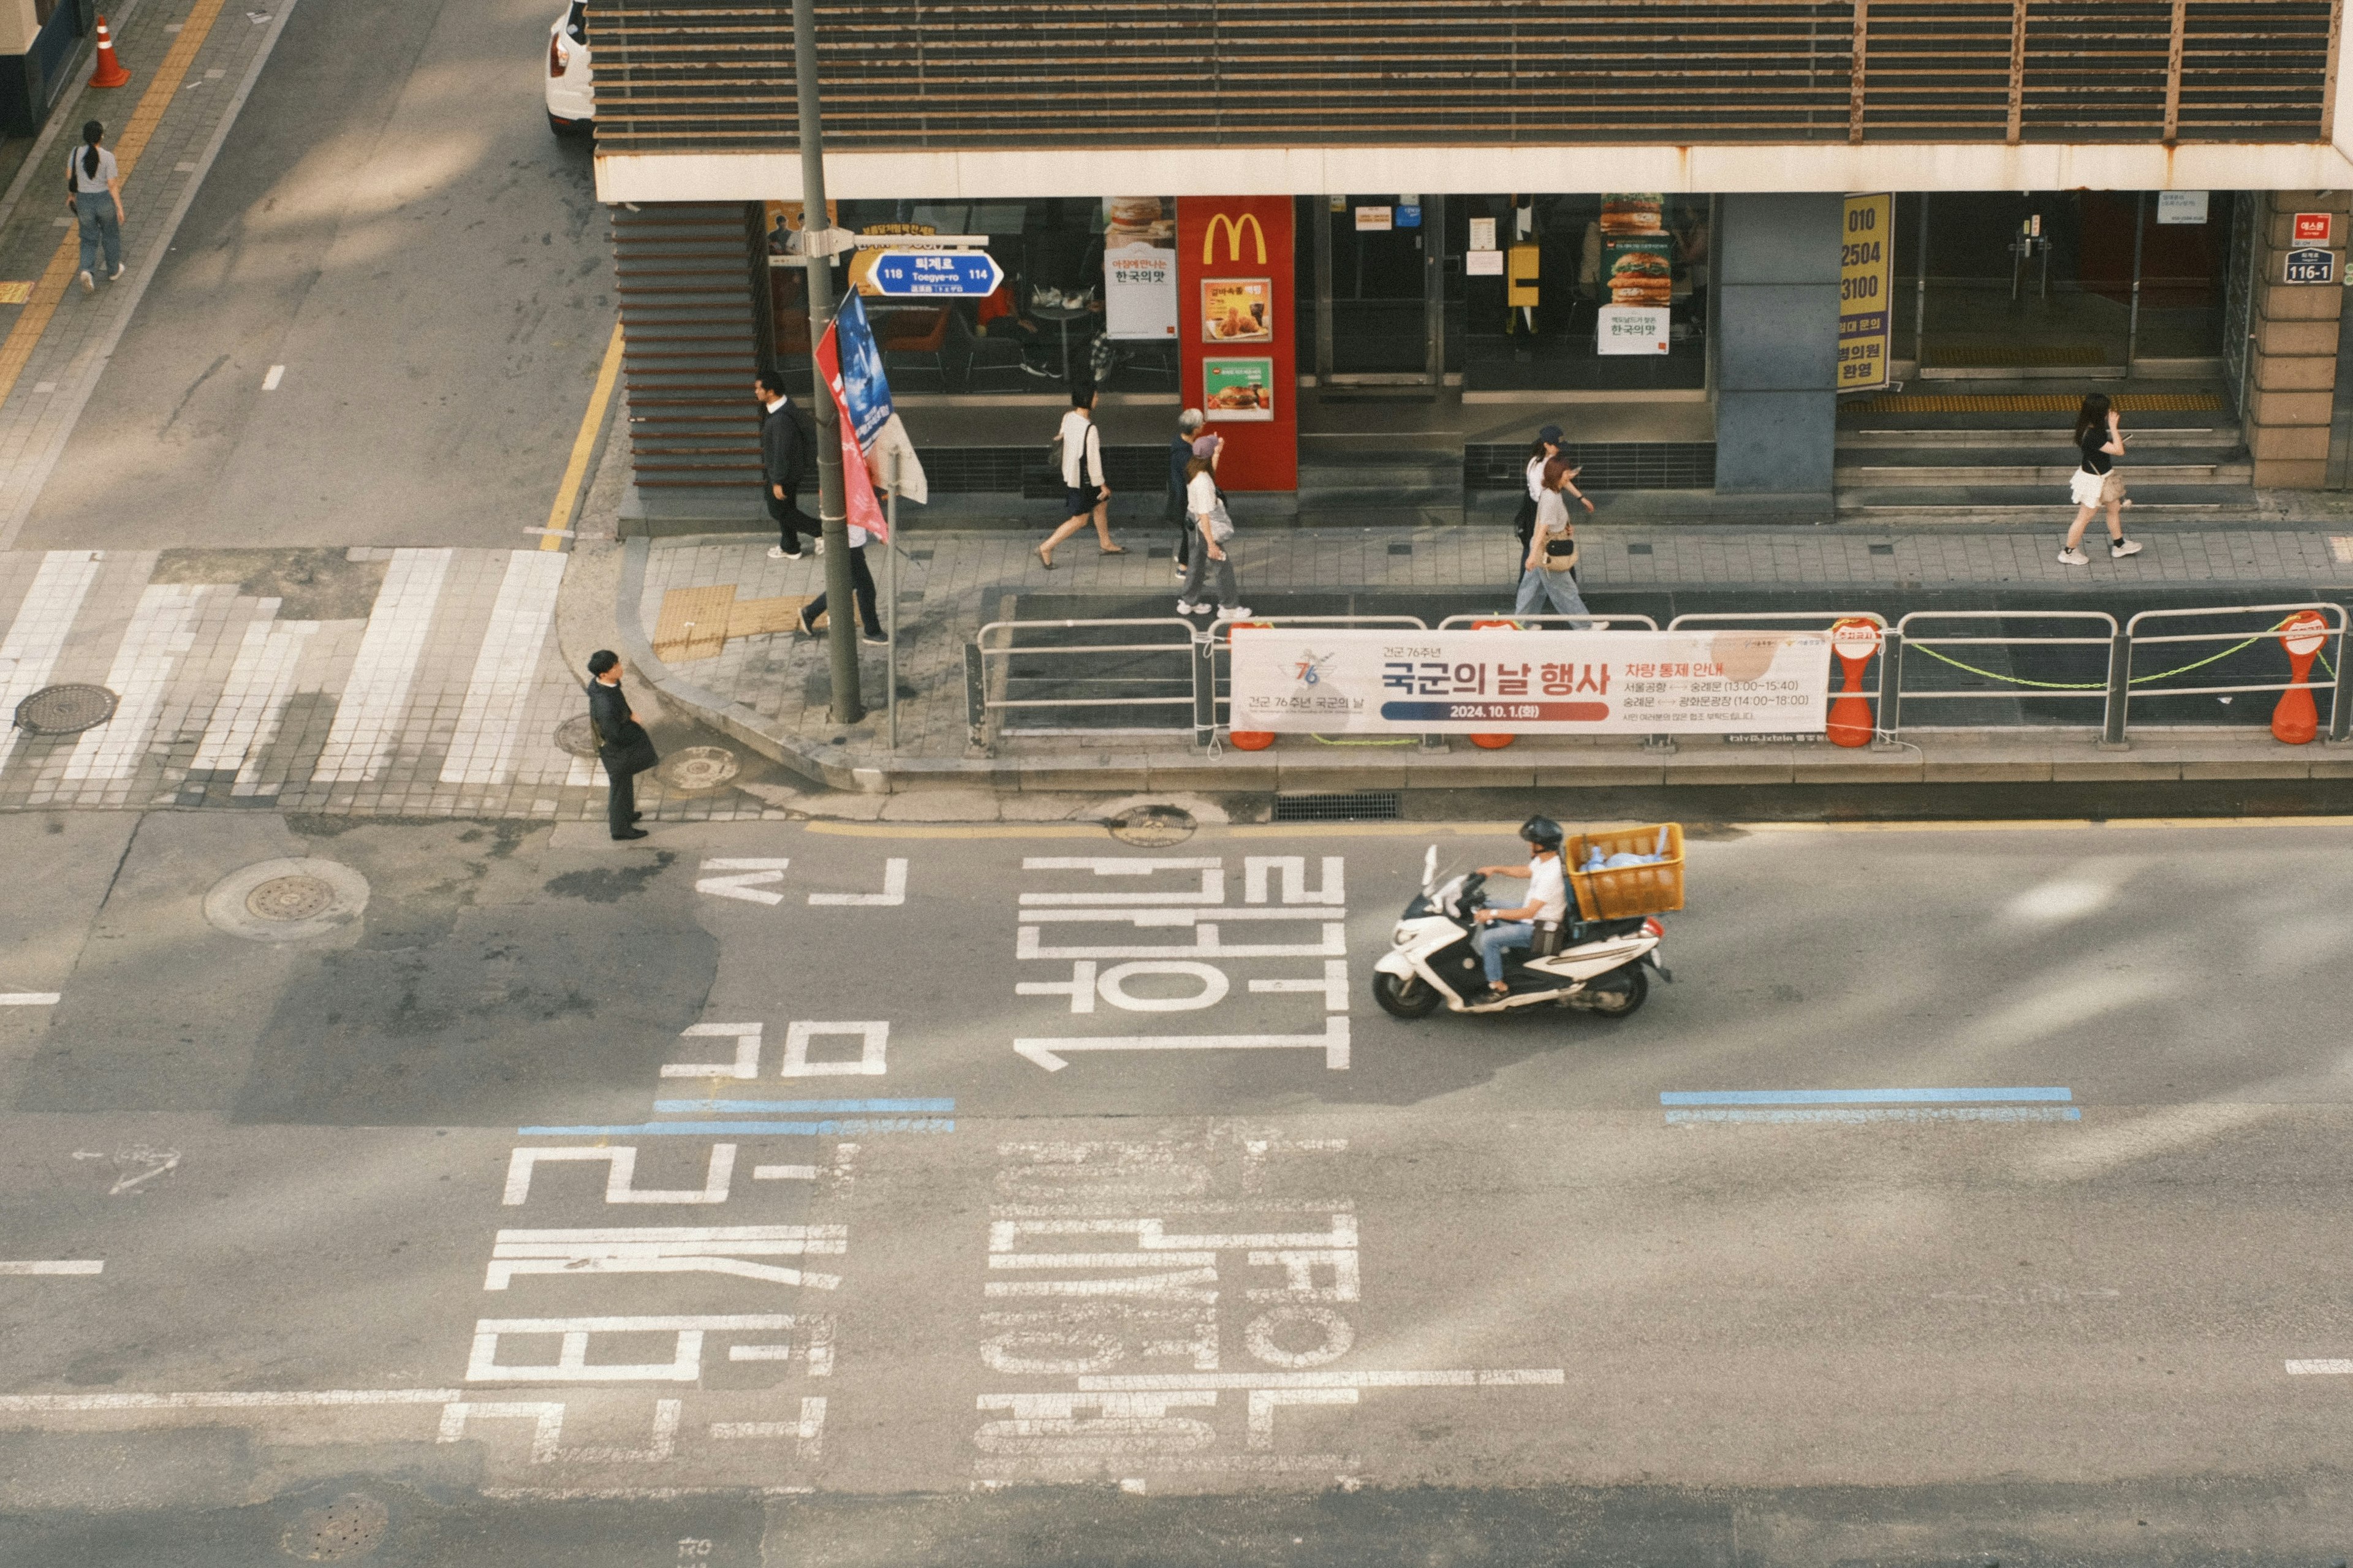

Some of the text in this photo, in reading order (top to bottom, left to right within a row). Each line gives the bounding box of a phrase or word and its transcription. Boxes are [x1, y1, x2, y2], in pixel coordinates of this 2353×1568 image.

[1849, 207, 1875, 233] 010
[2301, 222, 2324, 231] 에스원
[1841, 241, 1881, 267] 2504
[915, 257, 955, 271] 퇴계로
[884, 269, 903, 279] 118
[912, 272, 960, 282] Toegye-ro
[969, 270, 988, 279] 114
[1115, 270, 1165, 282] 한국의 맛
[2290, 265, 2328, 279] 116-1
[1841, 275, 1878, 301] 3100
[1612, 324, 1656, 335] 한국의 맛
[1860, 317, 1880, 331] 문의
[1838, 343, 1880, 362] 병의원
[1843, 362, 1872, 380] 환영
[1384, 647, 1441, 657] 건군 76주년
[1295, 662, 1319, 684] 76
[1625, 662, 1724, 678] 차량 통제 안내
[1382, 662, 1610, 696] 국군의 날 행사
[1624, 680, 1799, 693] 서울공항 숭례문 (13:00~15:40)
[1249, 697, 1270, 708] 건군
[1316, 697, 1349, 708] 국군의
[1353, 697, 1364, 708] 날
[1624, 695, 1809, 708] 숭례문 광화문광장 (14:00~18:00)
[1450, 705, 1487, 718] 2024.
[1488, 705, 1507, 718] 10.
[1639, 713, 1670, 721] 여러분의
[1012, 855, 1350, 1072] 1호터널
[466, 1143, 860, 1382] 퇴계로
